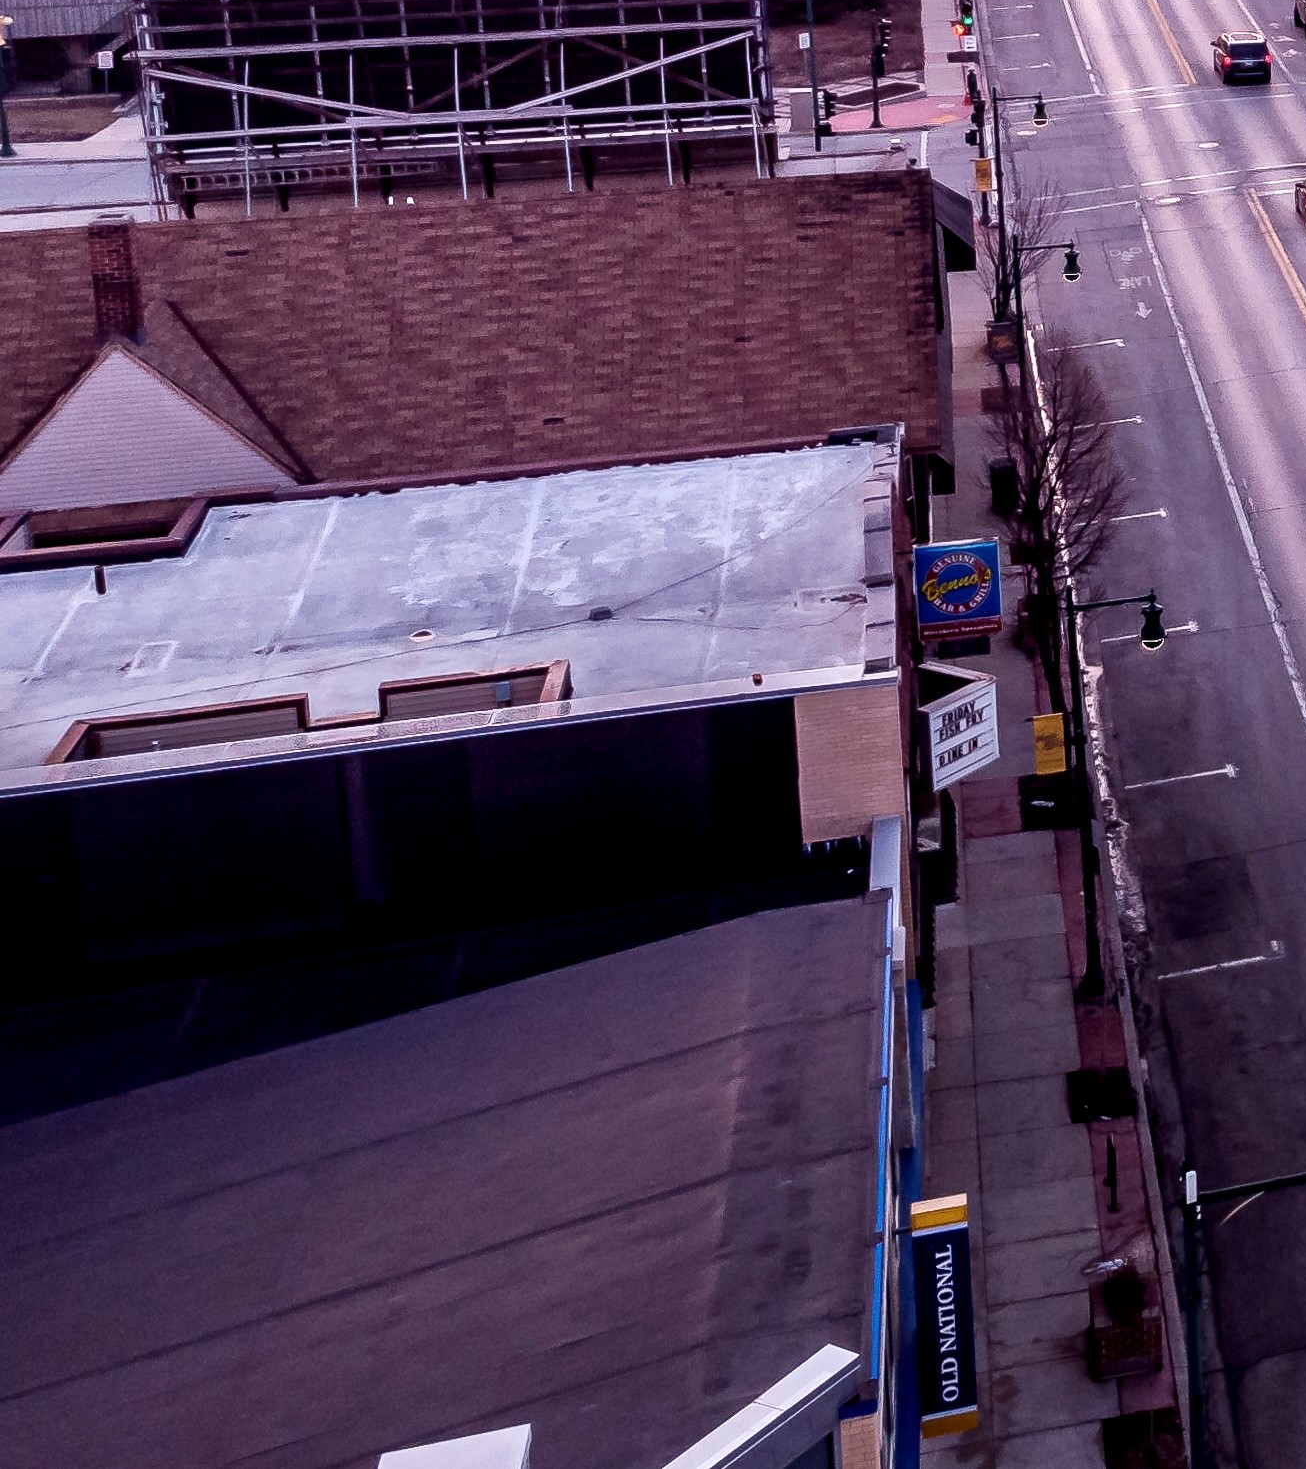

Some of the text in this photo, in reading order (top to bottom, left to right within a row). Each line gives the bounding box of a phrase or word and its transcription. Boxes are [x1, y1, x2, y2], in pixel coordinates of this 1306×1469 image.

[932, 554, 977, 573] GENUINE
[933, 597, 955, 613] BAR
[939, 710, 984, 744] FISH FRY
[941, 700, 976, 728] FRIDAY
[939, 737, 979, 770] DINE IN
[935, 1244, 959, 1402] OLD NATIONAL
